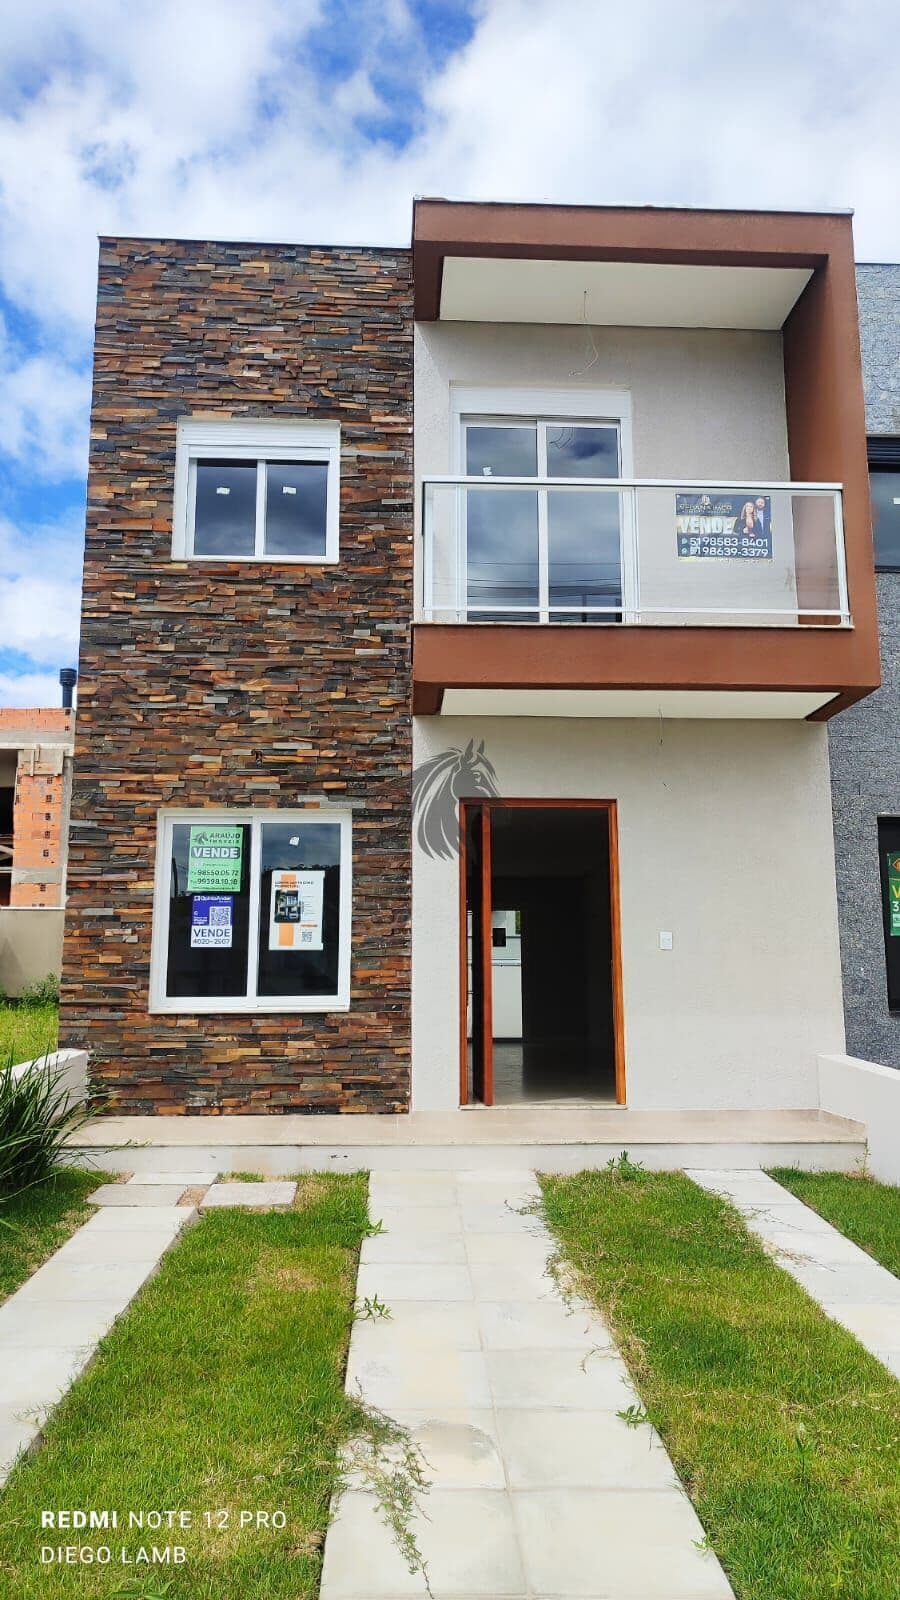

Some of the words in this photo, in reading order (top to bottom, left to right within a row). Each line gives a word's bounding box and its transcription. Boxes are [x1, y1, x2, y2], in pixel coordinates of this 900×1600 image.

[679, 516, 734, 534] VENDE
[690, 537, 700, 546] 51
[702, 537, 768, 547] 98583-8401
[702, 547, 768, 557] 98639-3379
[193, 847, 239, 858] VENDE
[193, 928, 231, 938] VENDE
